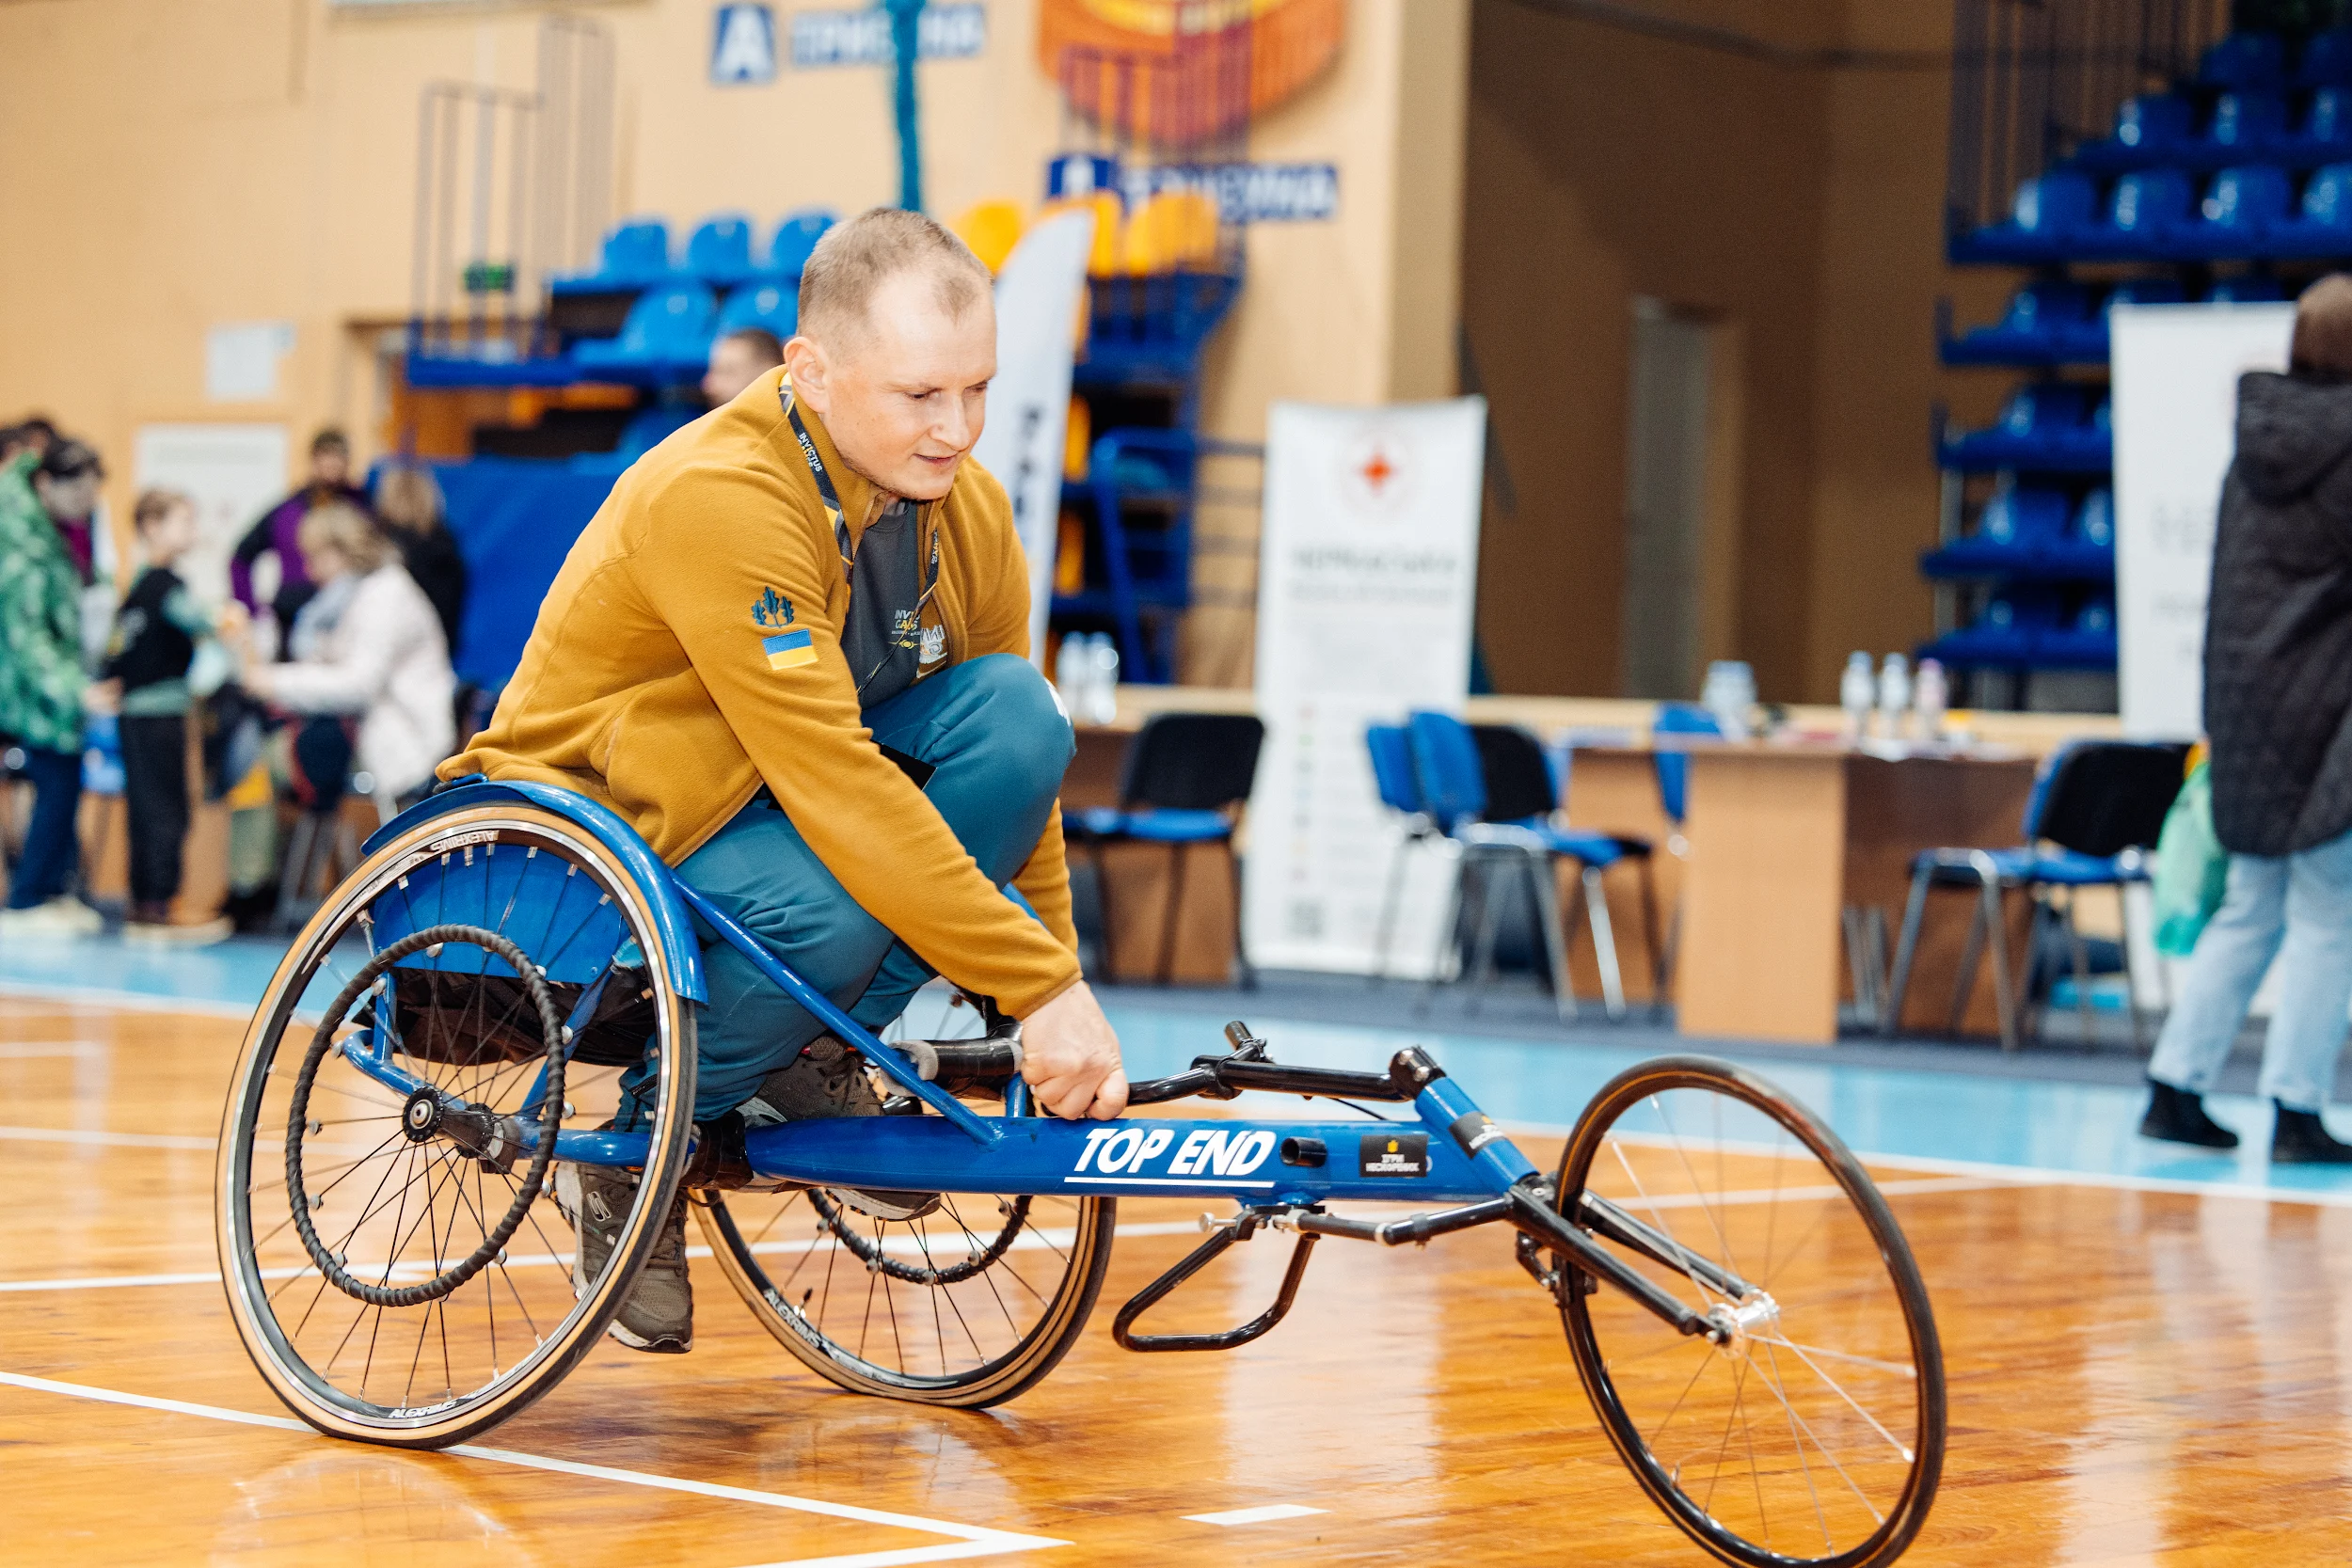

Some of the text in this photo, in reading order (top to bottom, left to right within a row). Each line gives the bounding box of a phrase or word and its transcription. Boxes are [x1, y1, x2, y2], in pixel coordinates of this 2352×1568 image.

[799, 433, 823, 472] INVICTUS
[430, 830, 499, 853] ALEXRIMS
[1073, 1128, 1277, 1176] TOP END
[763, 1289, 822, 1348] ALEXRIMS
